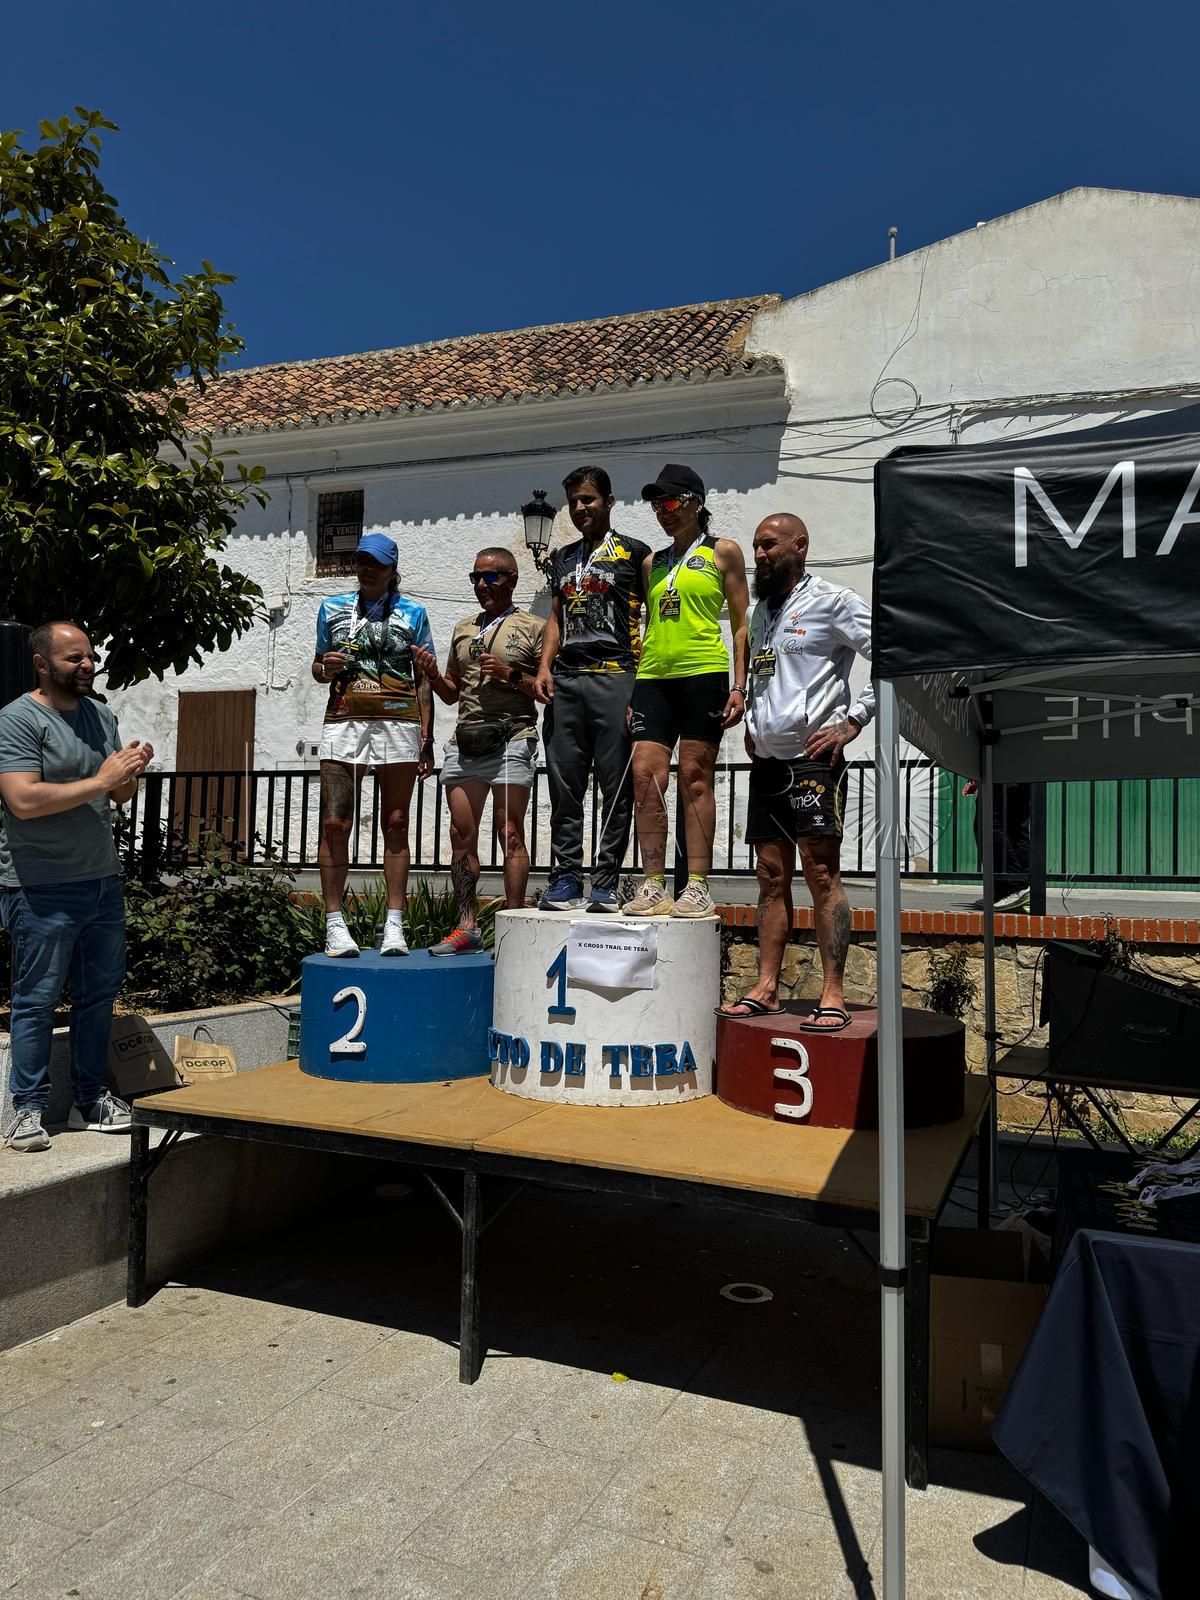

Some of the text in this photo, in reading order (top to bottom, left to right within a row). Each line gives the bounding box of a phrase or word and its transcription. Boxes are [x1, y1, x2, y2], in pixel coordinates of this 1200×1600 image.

[326, 525, 359, 536] SE VENDE
[546, 944, 577, 1016] 1
[329, 986, 367, 1053] 2
[540, 1041, 587, 1076] DE
[602, 1040, 698, 1077] TEBA
[771, 1037, 814, 1118] 3
